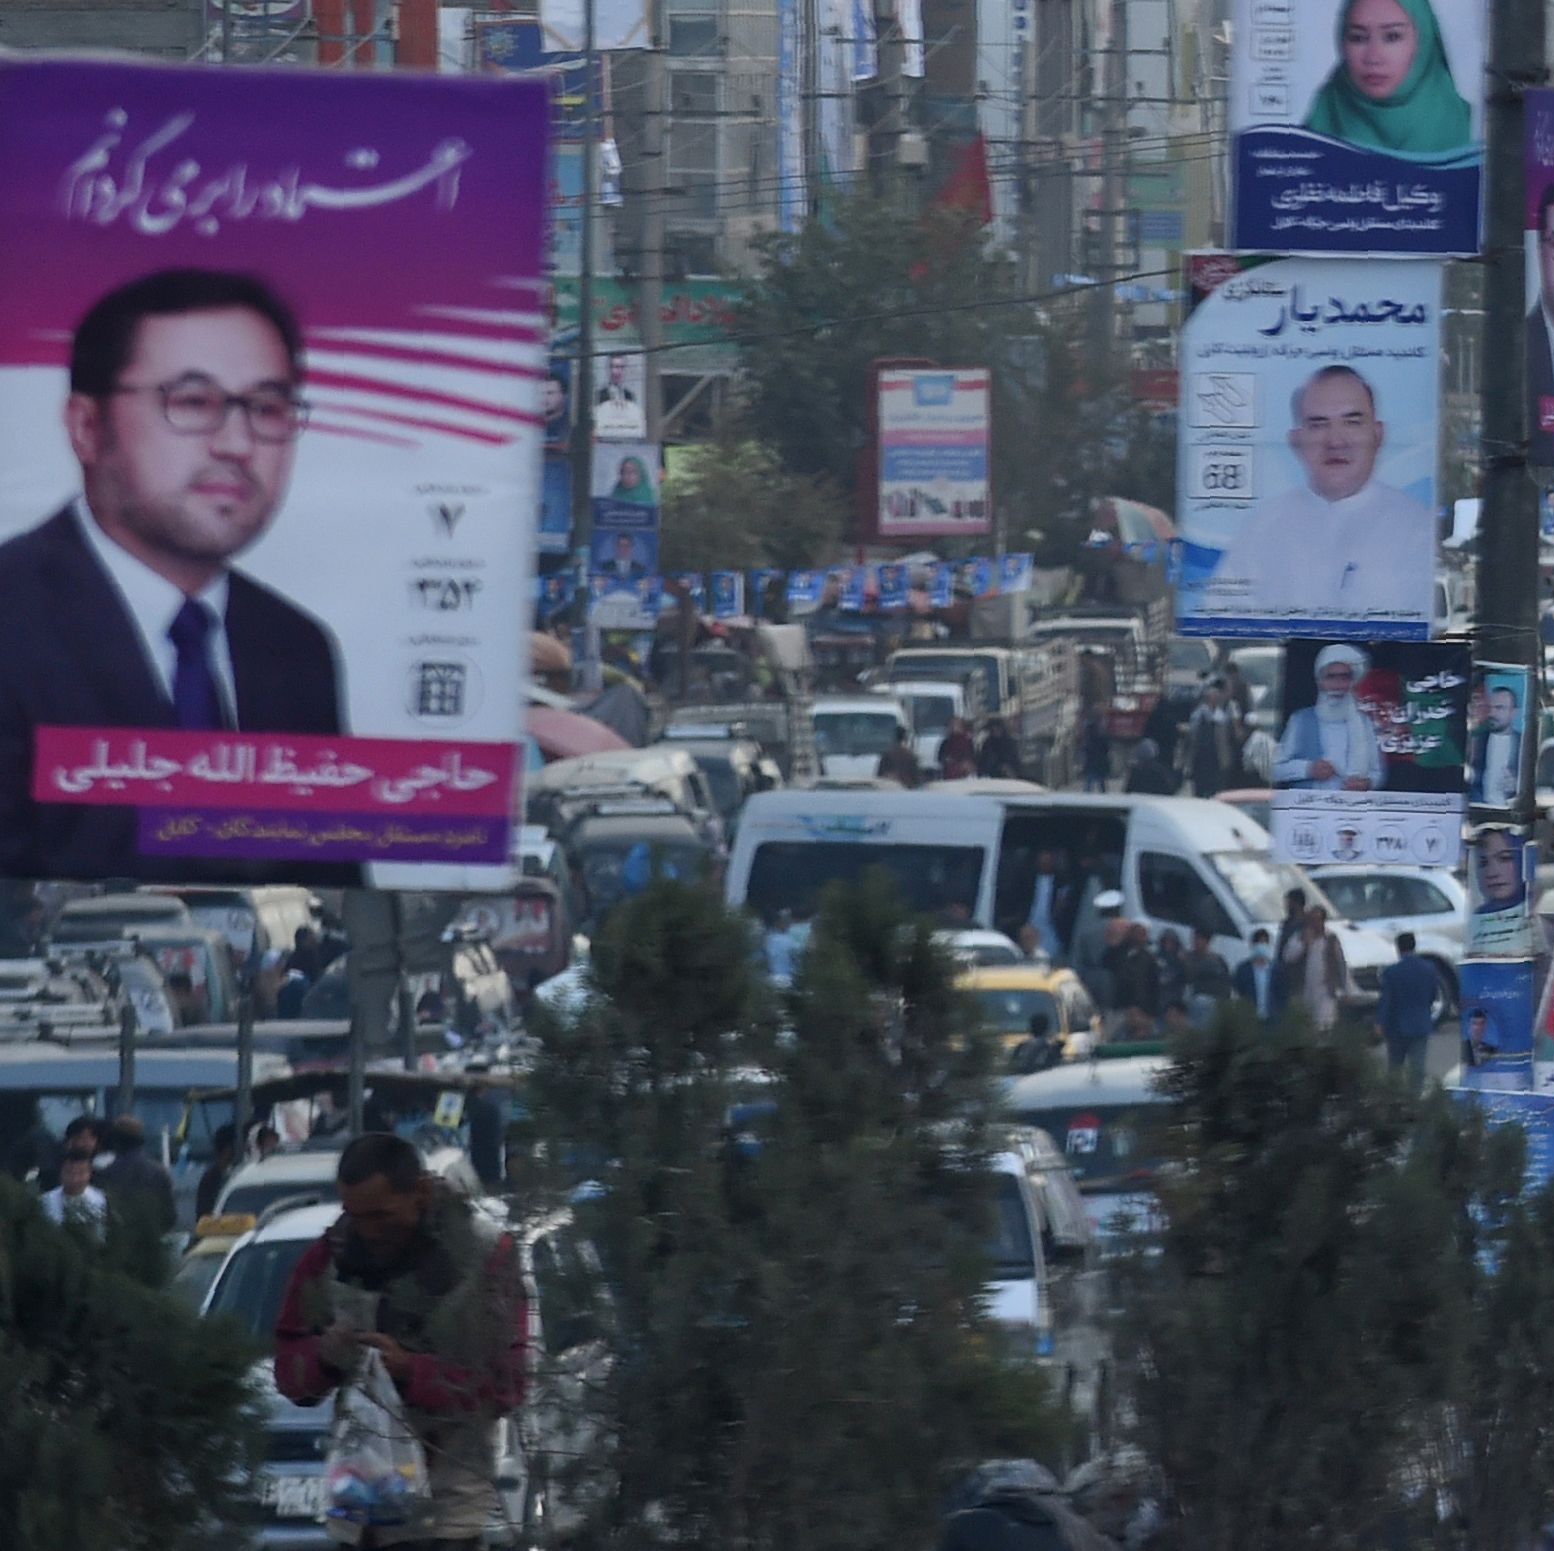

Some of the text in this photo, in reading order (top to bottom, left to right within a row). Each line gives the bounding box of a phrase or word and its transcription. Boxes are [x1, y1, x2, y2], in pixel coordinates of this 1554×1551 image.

[1405, 671, 1466, 693] حاجی
[52, 740, 498, 804] حاجی حفیظ الله جلیلی
